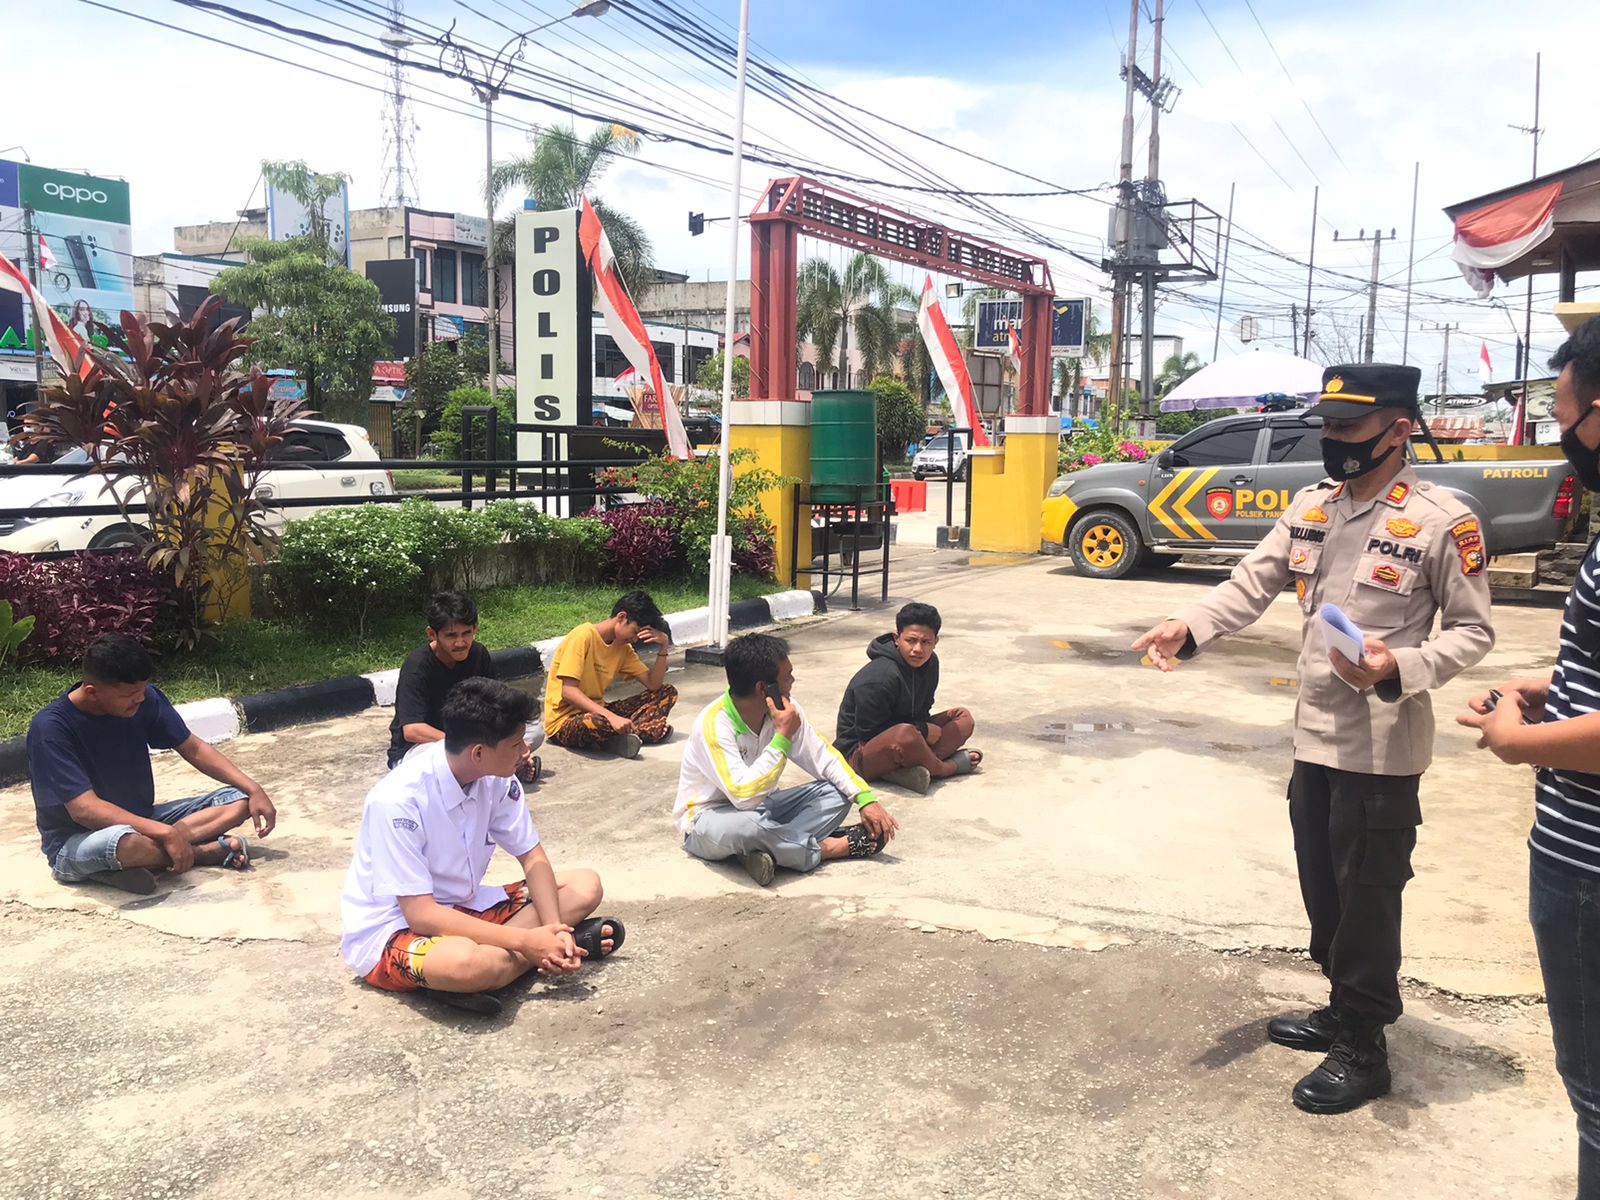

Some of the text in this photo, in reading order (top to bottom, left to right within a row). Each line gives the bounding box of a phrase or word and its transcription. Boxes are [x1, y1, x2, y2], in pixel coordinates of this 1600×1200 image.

[43, 182, 108, 204] oppo
[380, 303, 411, 313] MSUNG
[644, 394, 658, 403] FAR
[1483, 467, 1549, 479] PATROLI
[1235, 488, 1290, 511] POL
[1235, 510, 1285, 519] POLSEK PANG
[1367, 538, 1422, 563] POLRI
